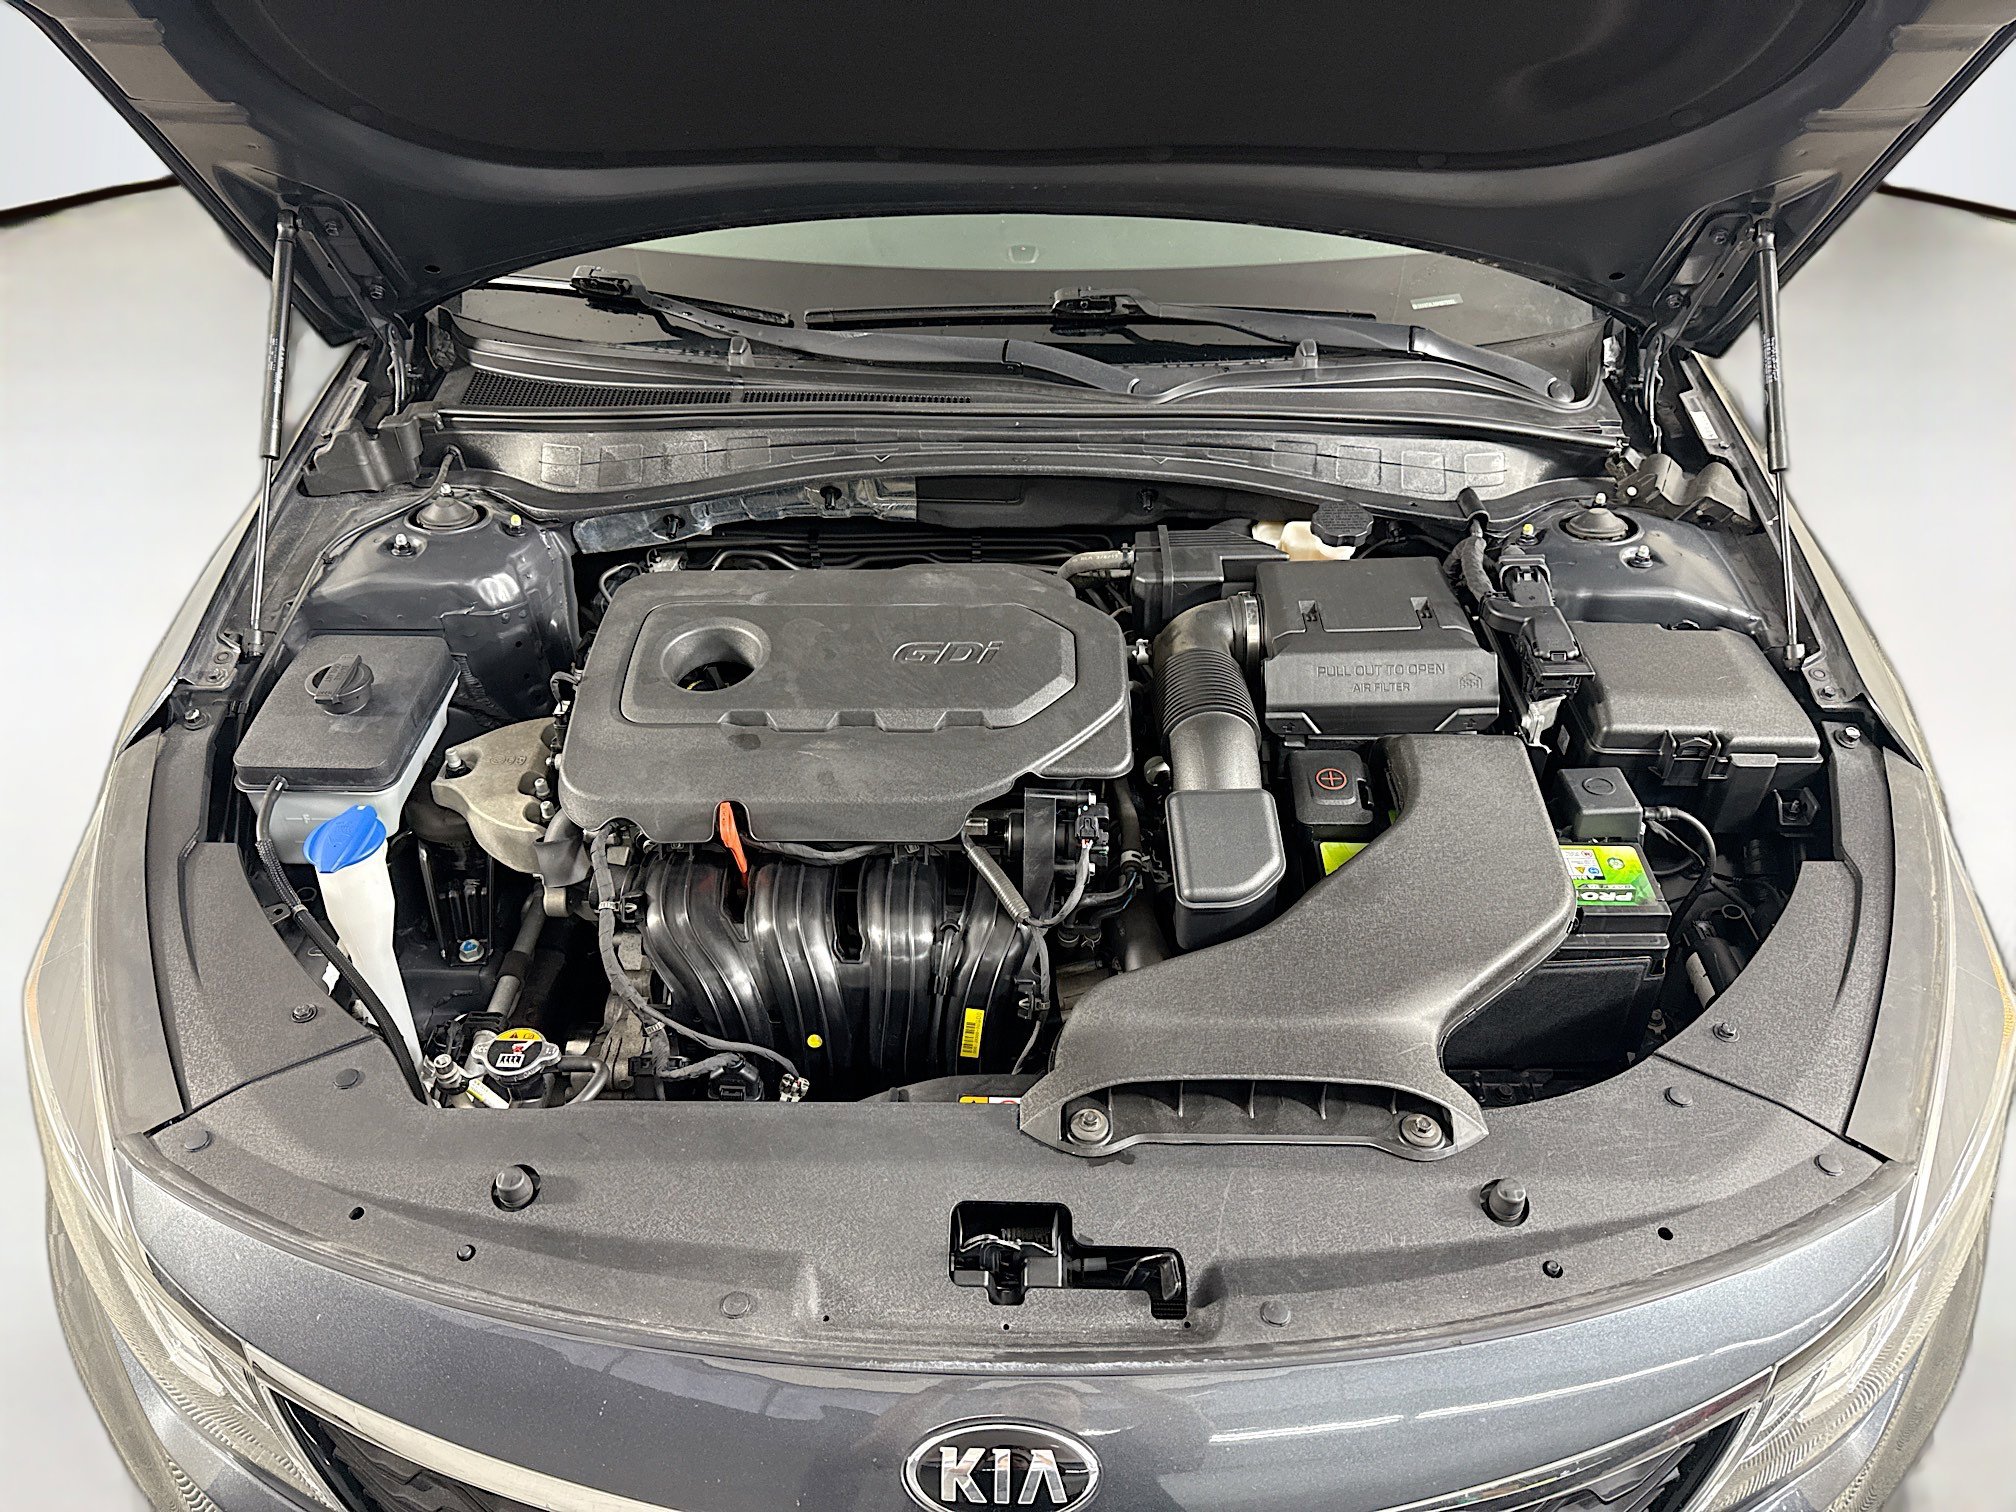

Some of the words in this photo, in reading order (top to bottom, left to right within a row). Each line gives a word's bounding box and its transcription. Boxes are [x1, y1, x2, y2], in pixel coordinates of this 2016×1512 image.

[892, 640, 1004, 665] GDi
[1316, 665, 1352, 678] PULL
[1354, 664, 1383, 677] OUT
[1385, 663, 1405, 676] TO
[1407, 662, 1446, 676] OPEN
[1352, 682, 1372, 693] AIR
[1373, 681, 1411, 693] FILTER
[1580, 892, 1633, 902] PRO
[939, 1446, 1068, 1505] KIA
